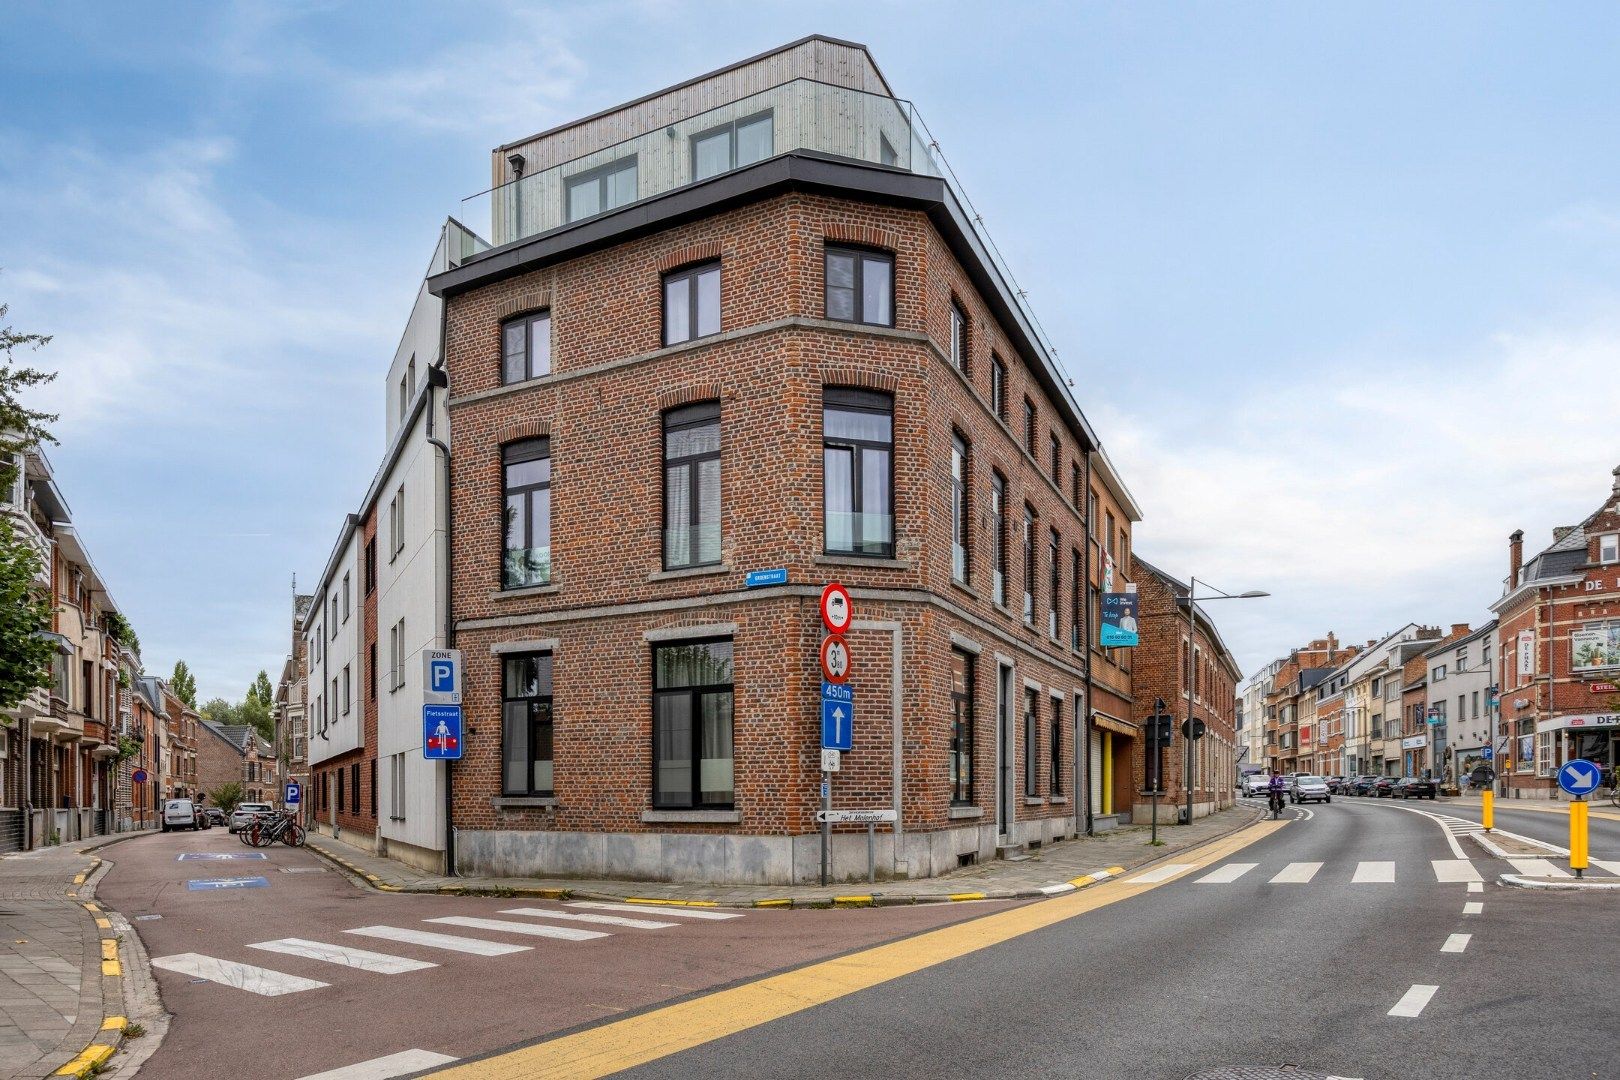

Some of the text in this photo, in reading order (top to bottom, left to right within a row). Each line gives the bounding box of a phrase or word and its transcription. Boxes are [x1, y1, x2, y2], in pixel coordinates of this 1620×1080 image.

[1585, 580, 1602, 591] DE
[831, 650, 836, 668] 3
[434, 666, 450, 687] P
[826, 684, 850, 699] 450m
[288, 786, 298, 800] P
